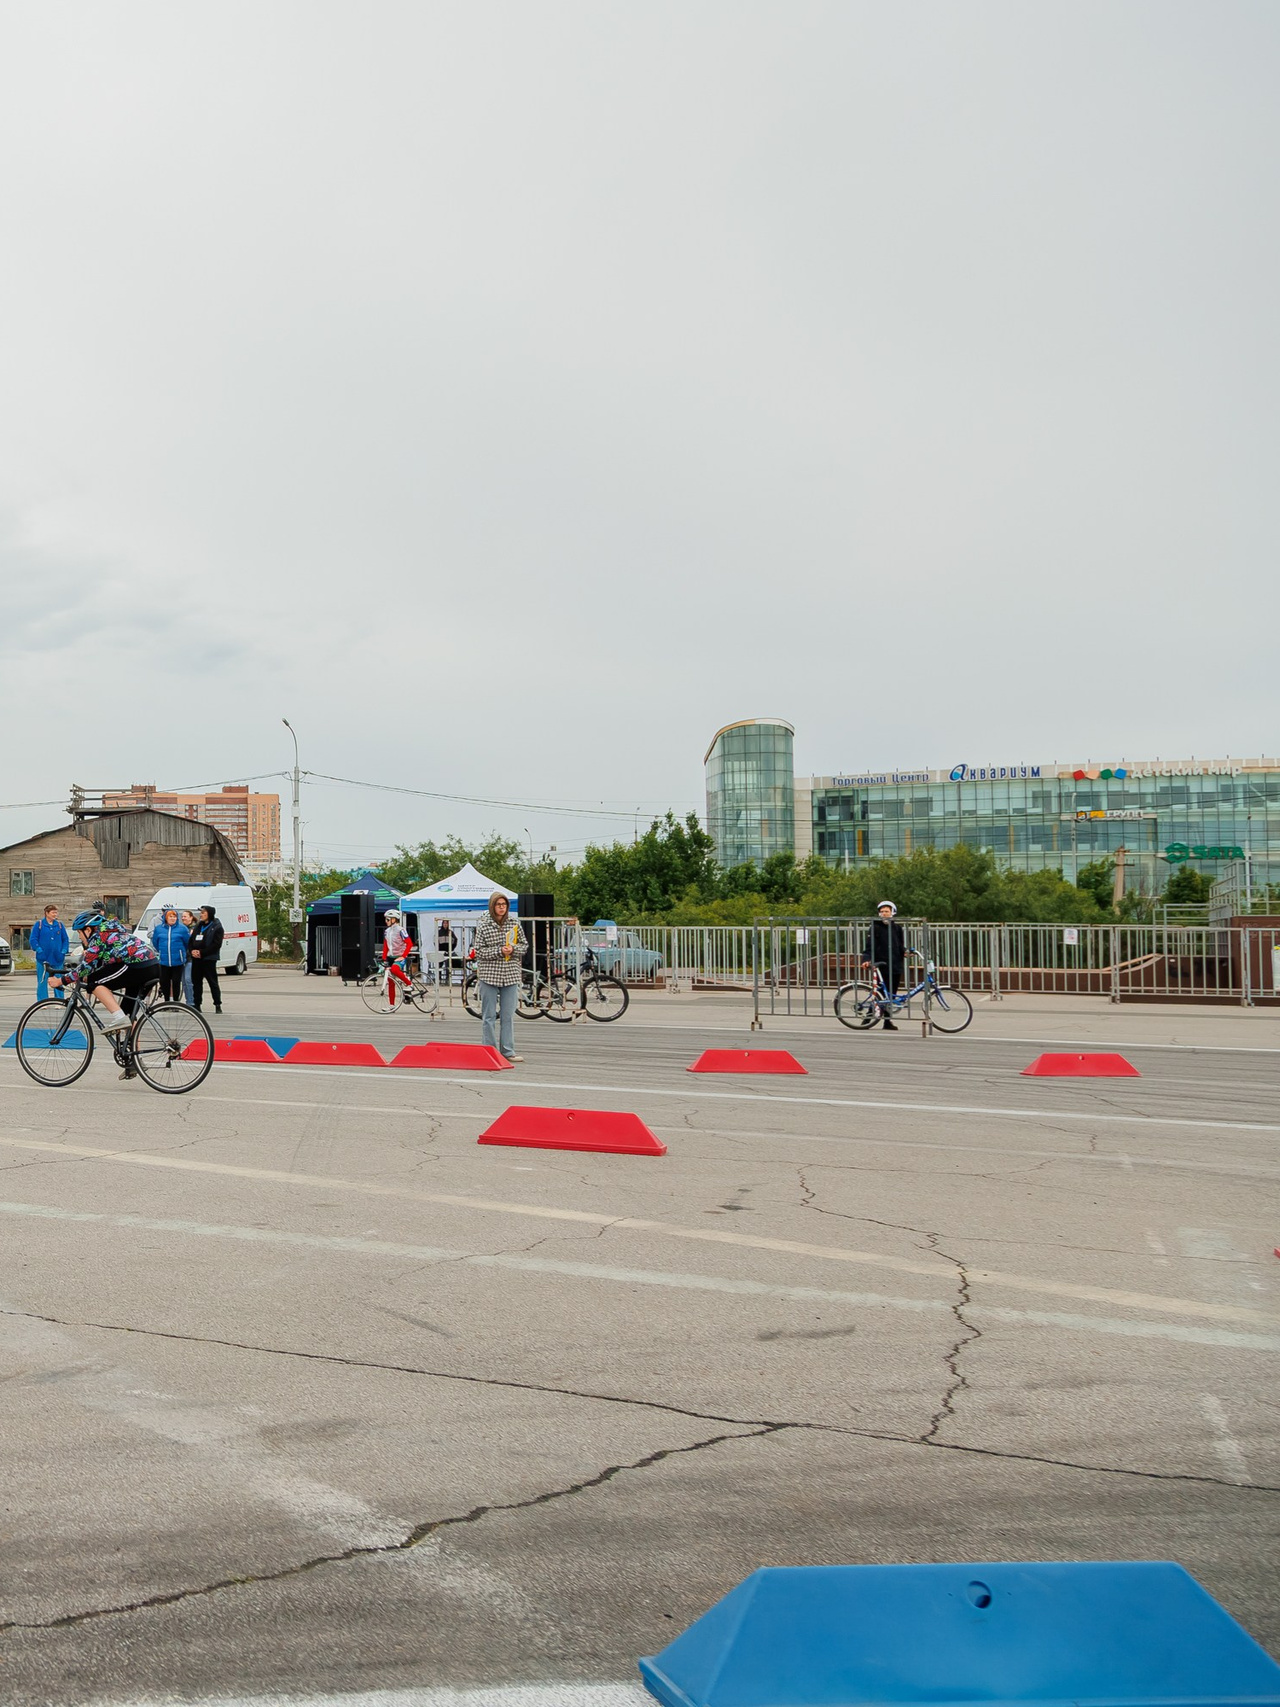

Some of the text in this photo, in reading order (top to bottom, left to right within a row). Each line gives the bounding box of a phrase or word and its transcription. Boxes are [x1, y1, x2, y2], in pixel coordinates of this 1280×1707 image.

[1131, 766, 1243, 779] детский мир
[831, 773, 929, 787] Торговый Центр
[1193, 845, 1246, 860] SATA
